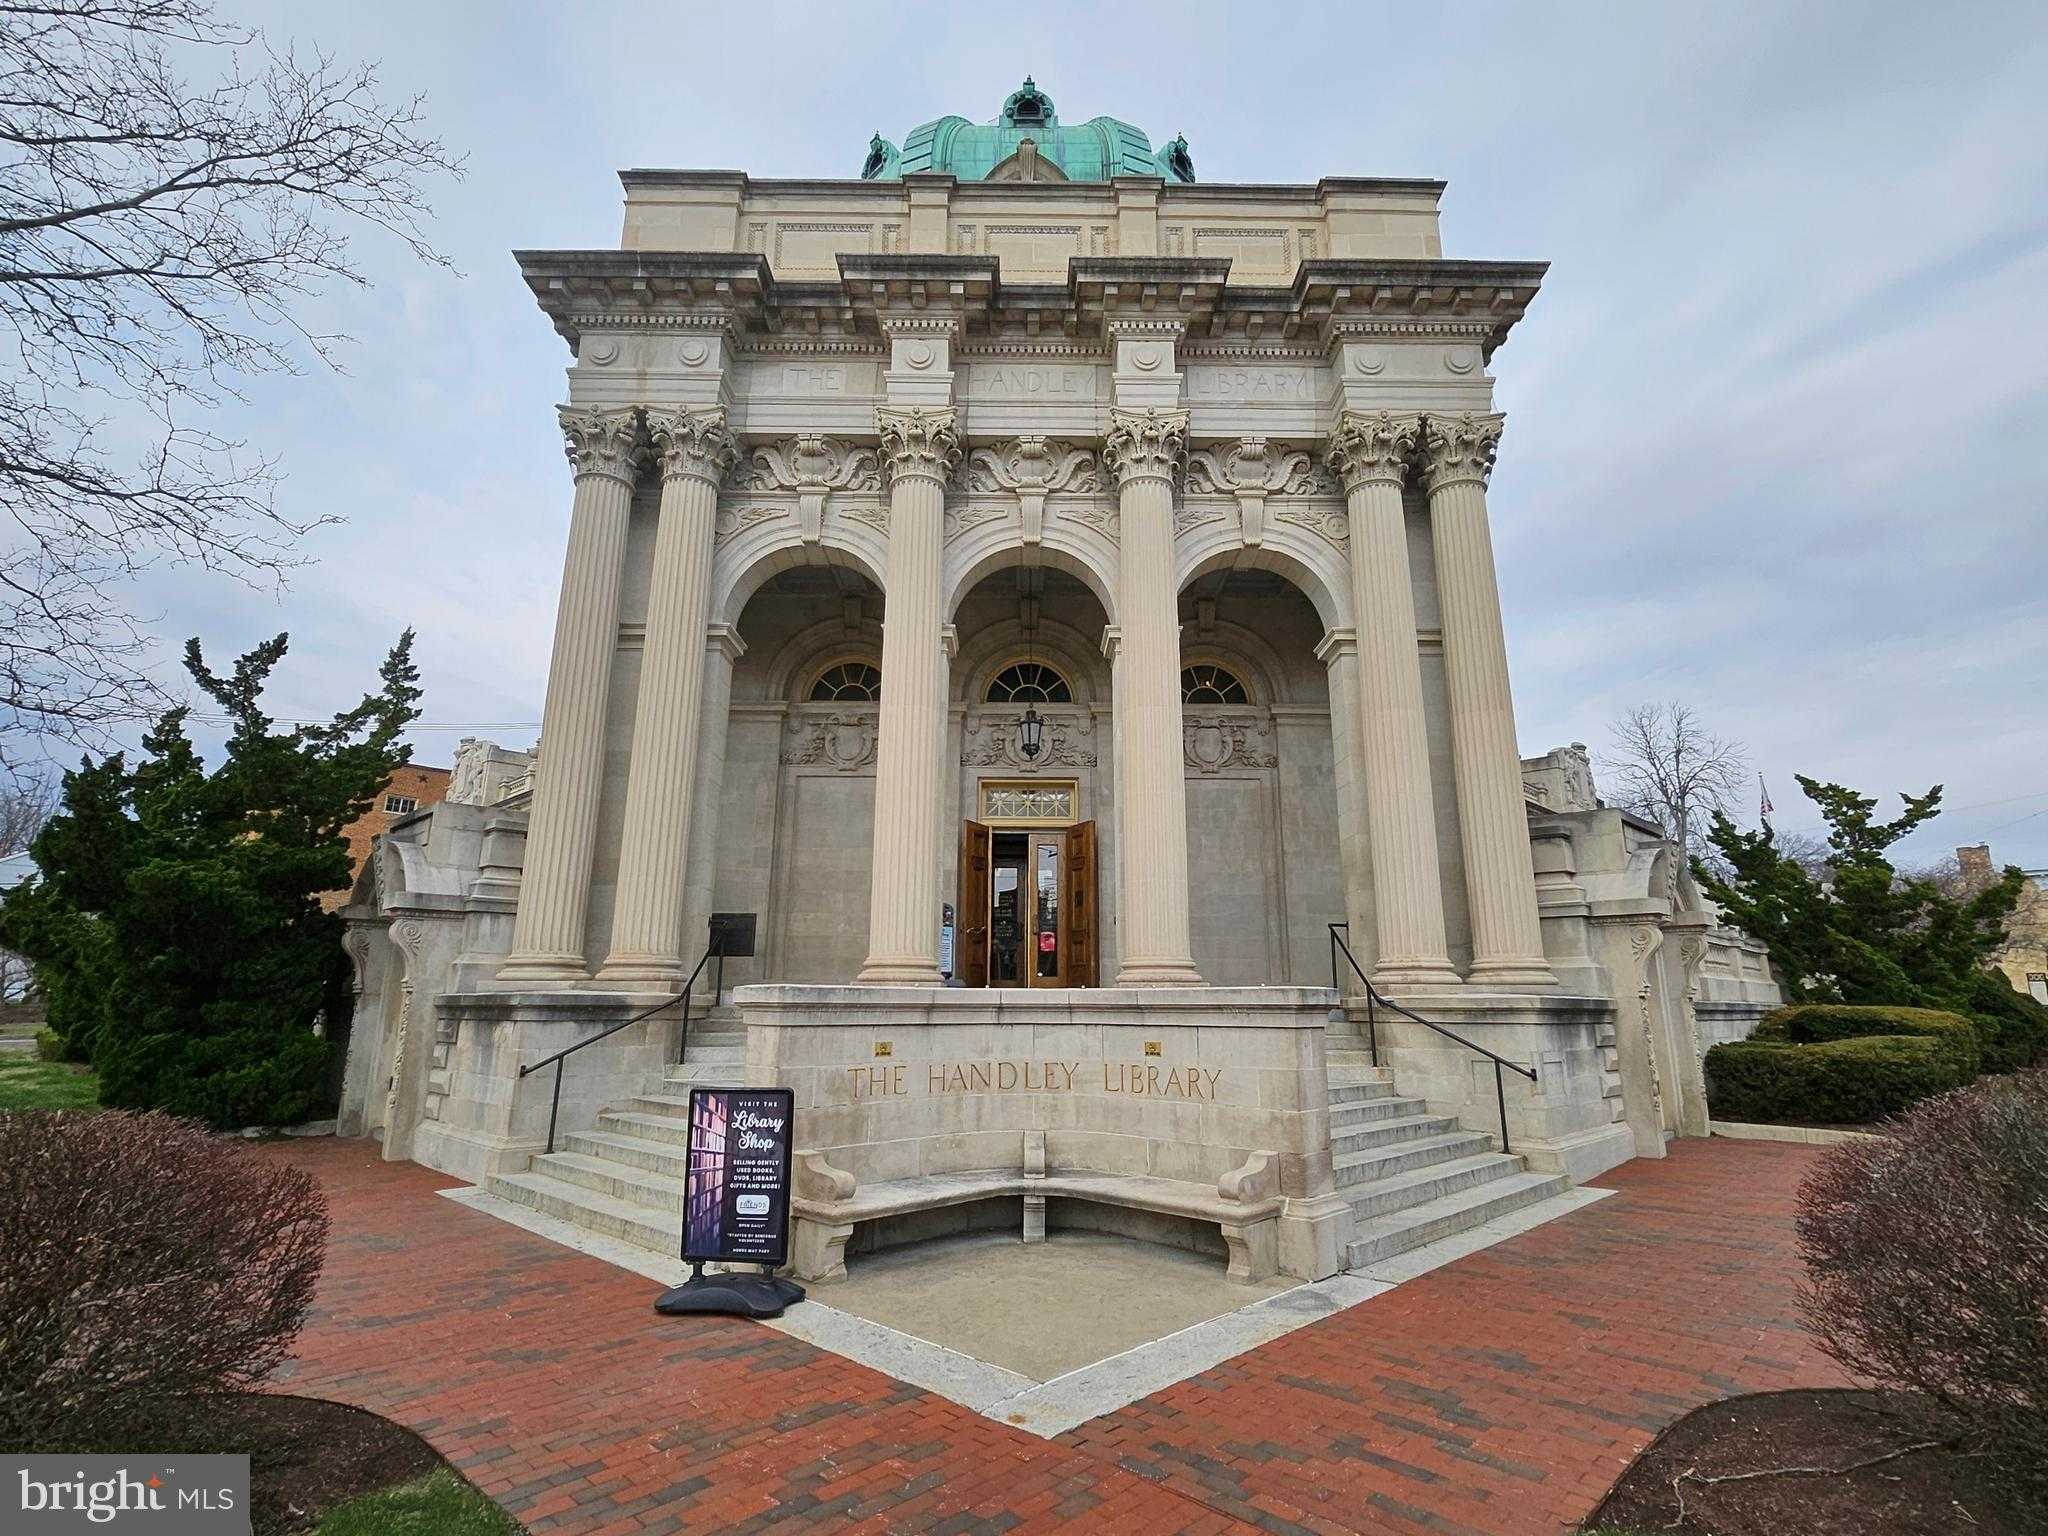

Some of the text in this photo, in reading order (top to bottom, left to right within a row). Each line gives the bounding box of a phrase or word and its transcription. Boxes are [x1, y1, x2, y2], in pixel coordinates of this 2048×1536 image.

[789, 368, 1307, 395] THE HANDLEY LIBRARY
[847, 1062, 1222, 1100] THE HANDLEY LIBRARY
[731, 1110, 785, 1133] Library
[738, 1130, 775, 1152] Shop
